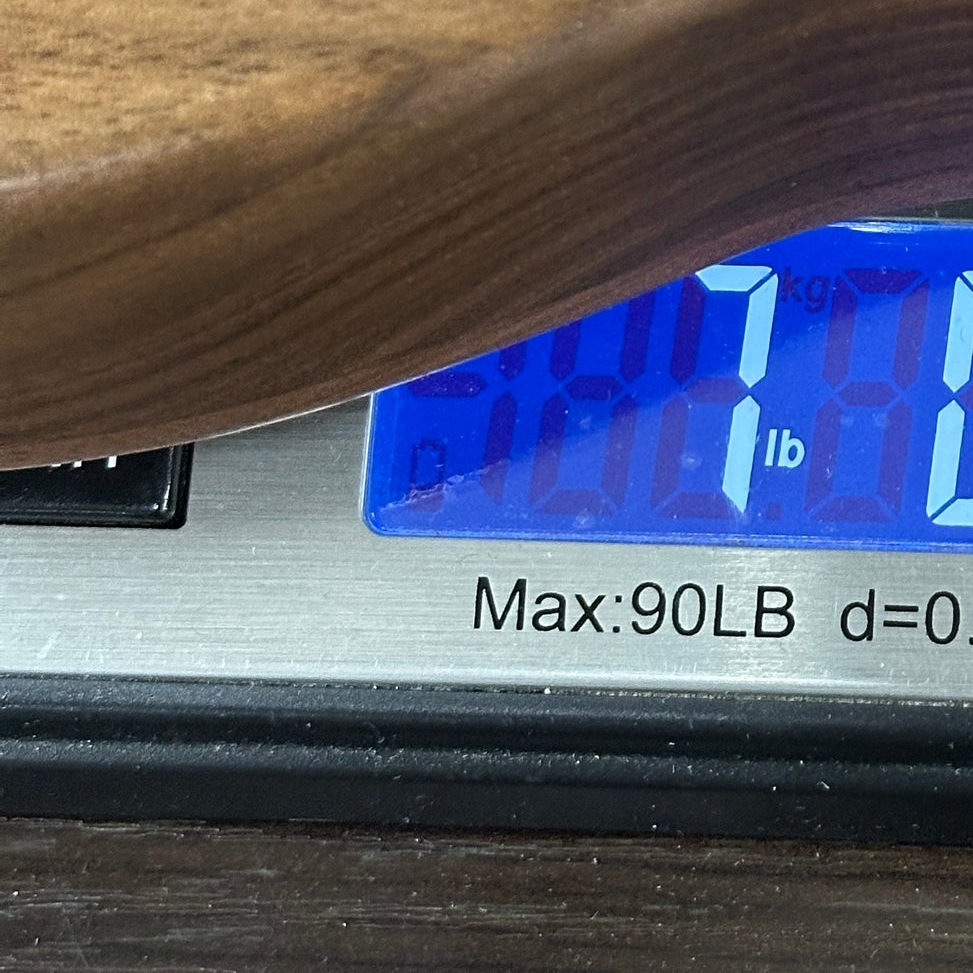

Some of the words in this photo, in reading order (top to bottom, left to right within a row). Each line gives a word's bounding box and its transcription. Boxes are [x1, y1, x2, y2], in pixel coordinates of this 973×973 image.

[695, 264, 779, 514] 7
[764, 428, 806, 469] lb
[473, 575, 796, 639] Max:90LB
